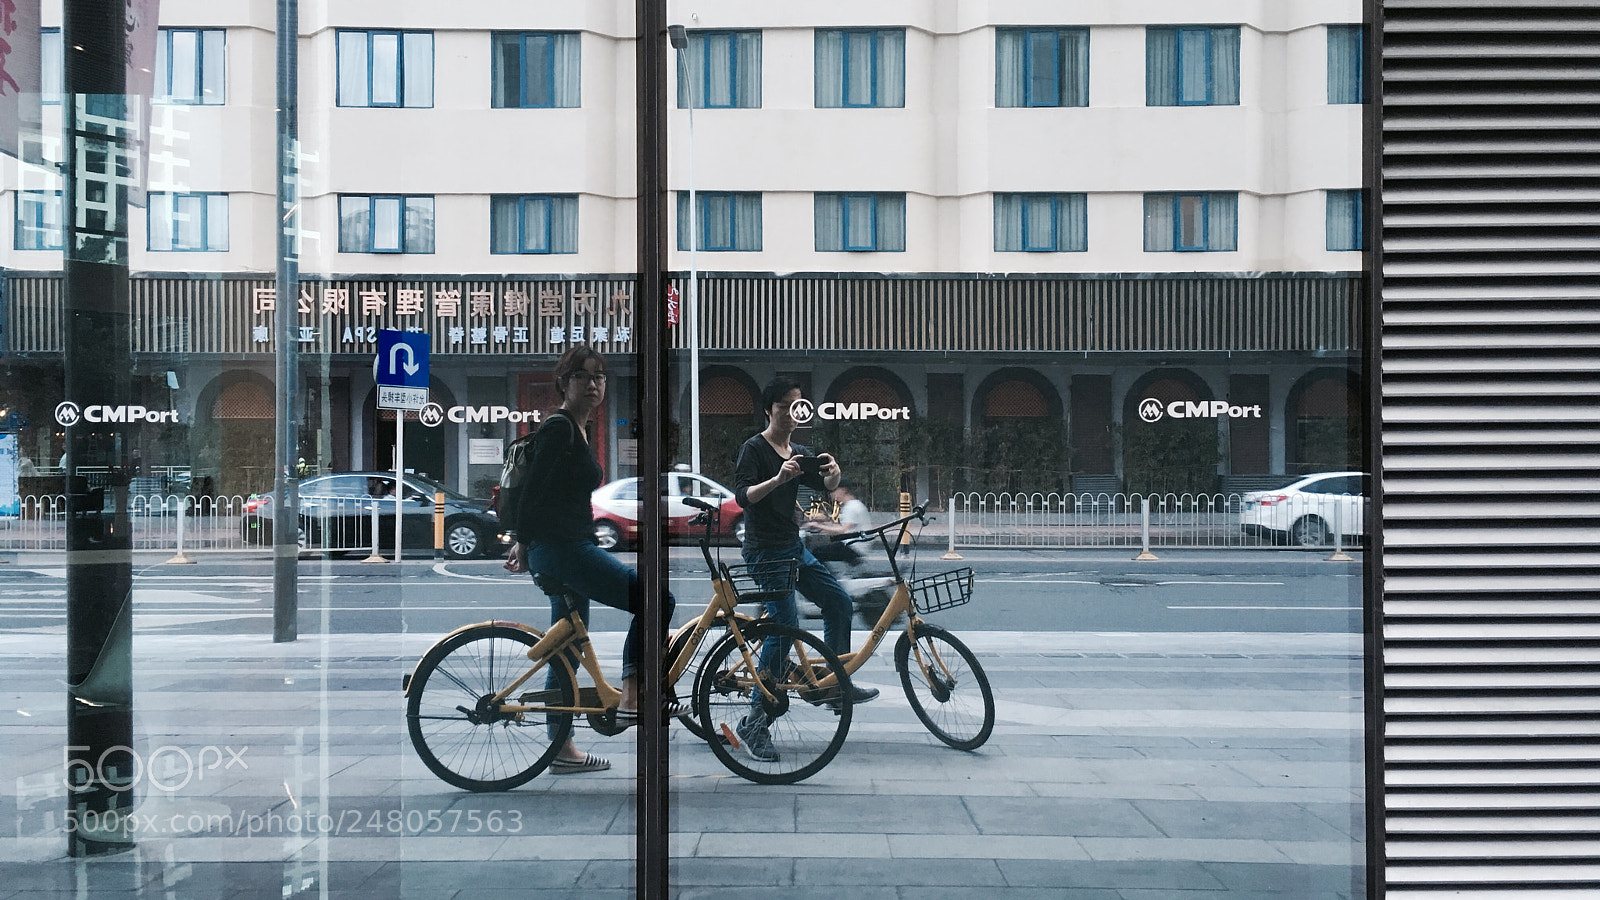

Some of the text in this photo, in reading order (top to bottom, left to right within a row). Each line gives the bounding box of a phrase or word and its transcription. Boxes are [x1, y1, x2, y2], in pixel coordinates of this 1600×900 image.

[83, 405, 179, 423] CMPort
[447, 405, 541, 424] CMPort
[817, 402, 910, 420] CMPort
[1166, 400, 1262, 419] CMPort
